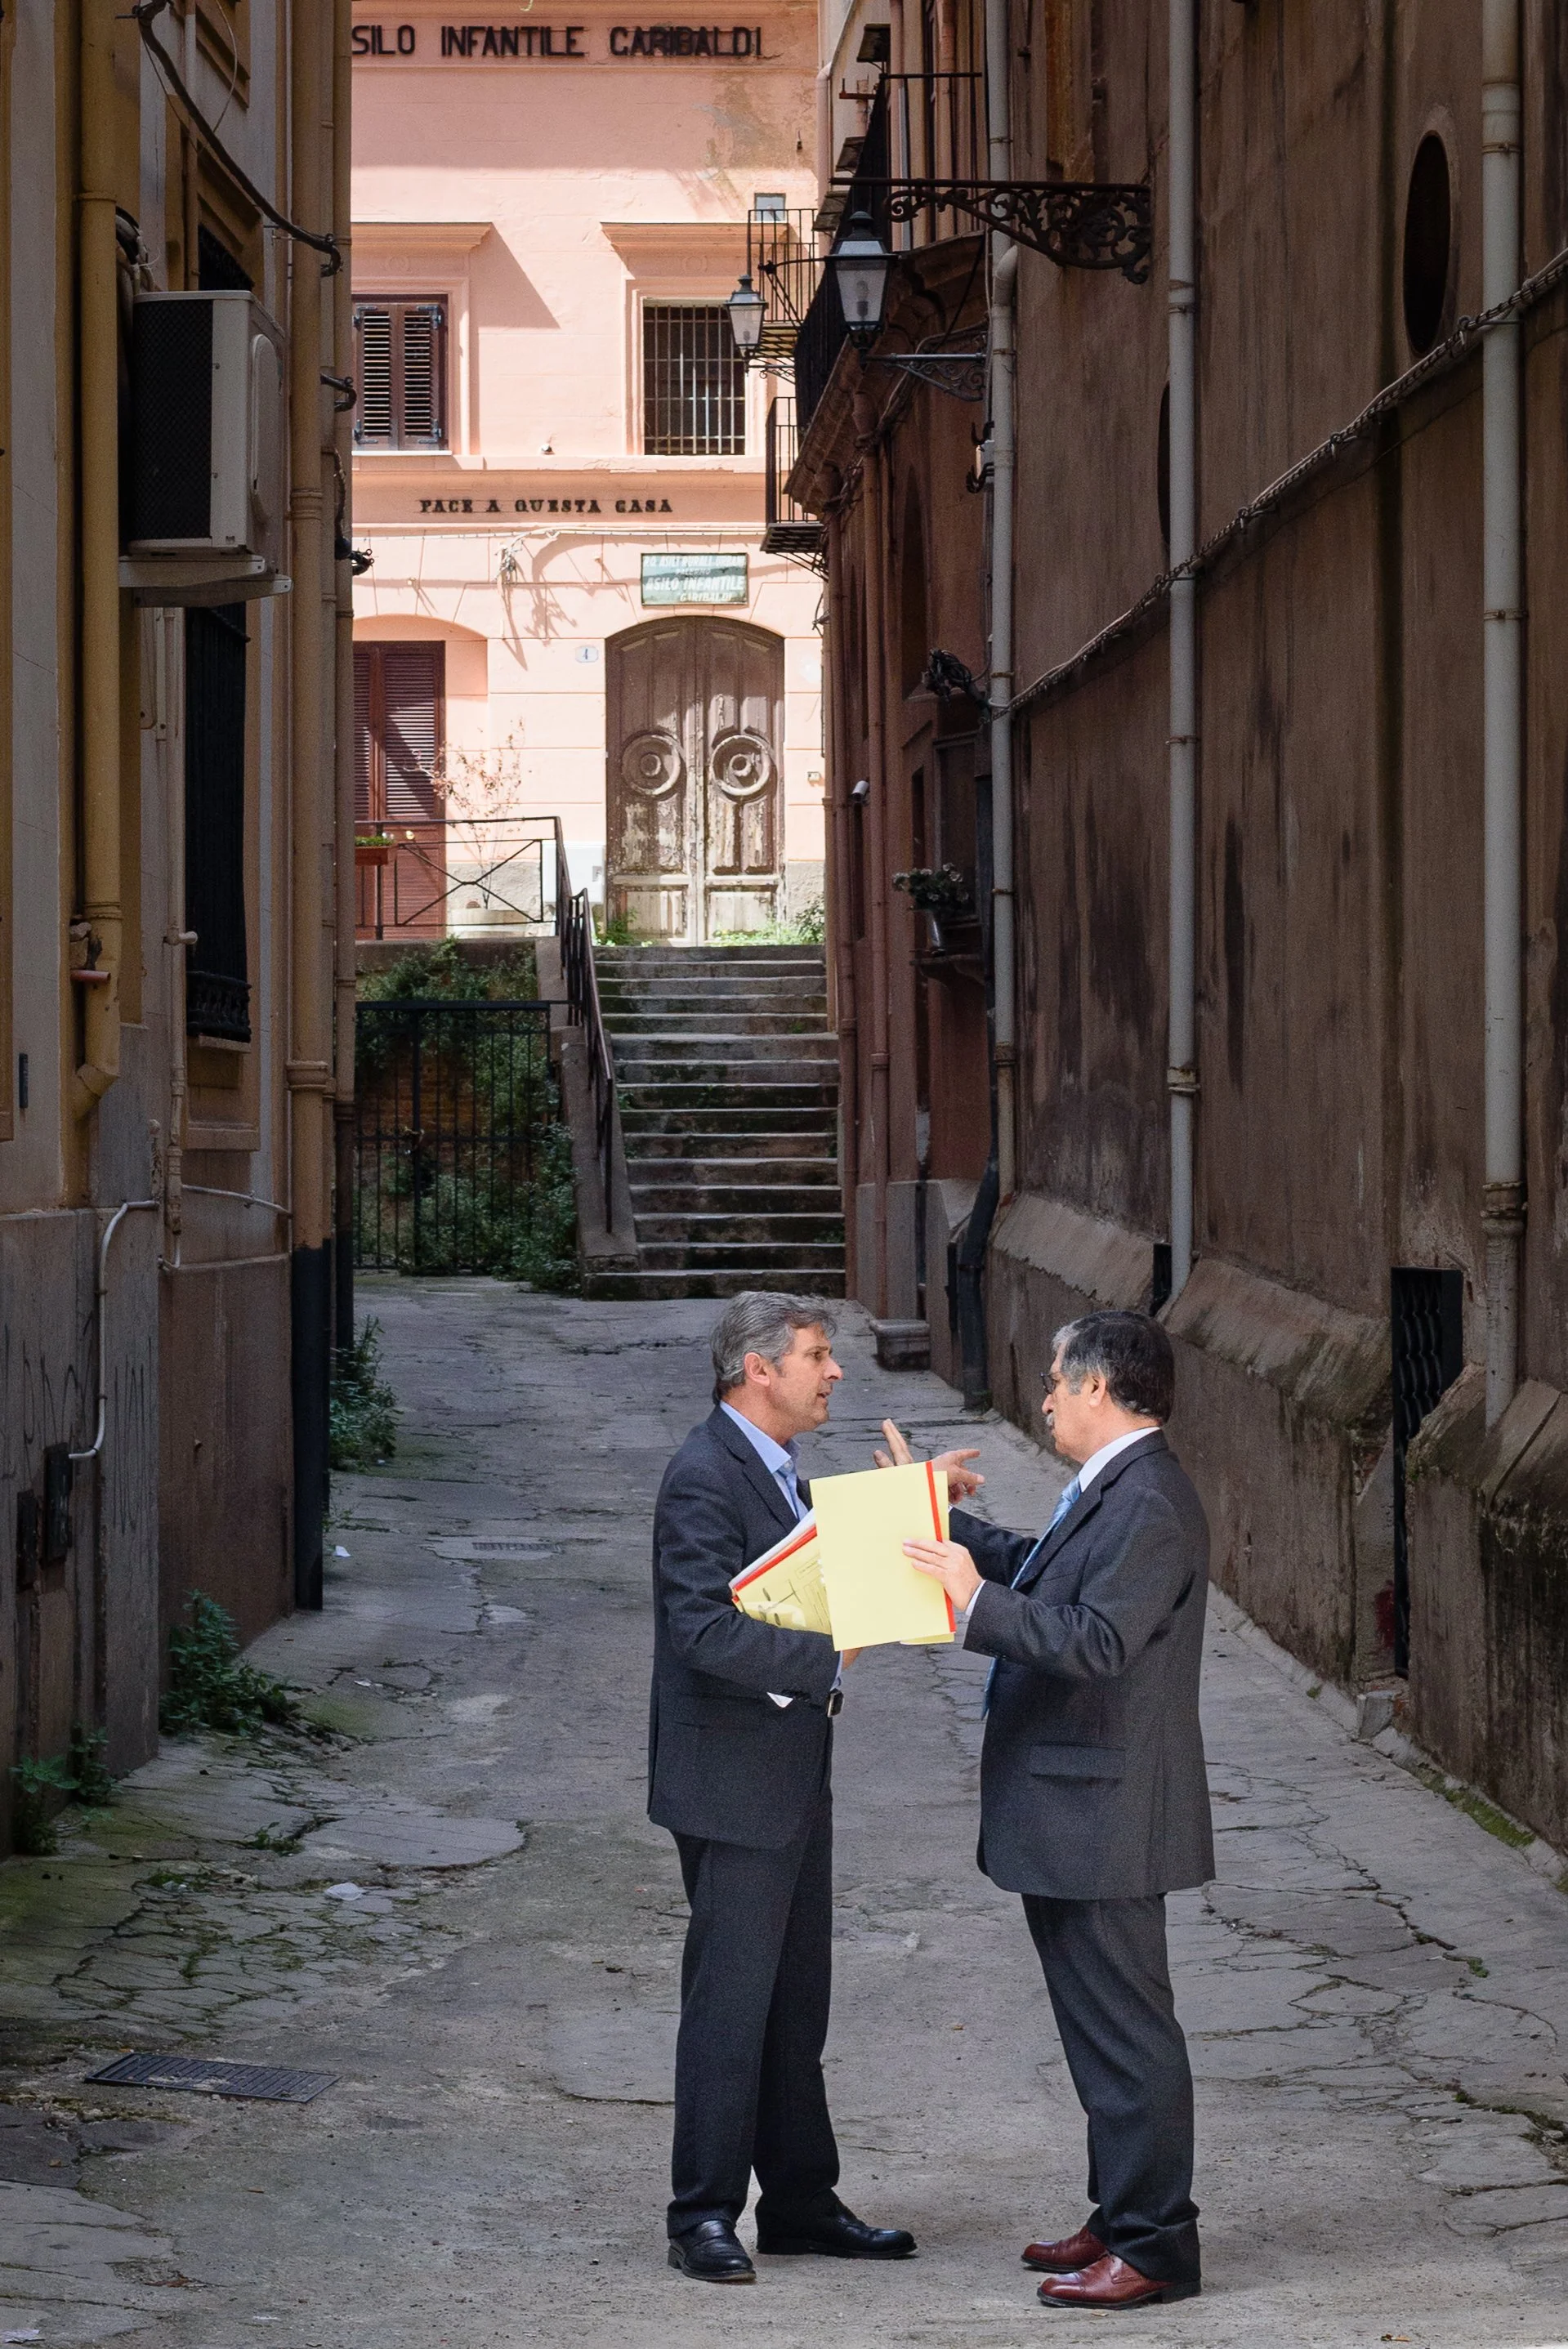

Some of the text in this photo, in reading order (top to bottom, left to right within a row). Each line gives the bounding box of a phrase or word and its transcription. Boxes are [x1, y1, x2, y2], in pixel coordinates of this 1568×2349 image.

[441, 25, 585, 56] INFANTILE
[418, 498, 673, 514] PACE A QUESTA CASA
[645, 574, 745, 591] ASILO INFANTILE
